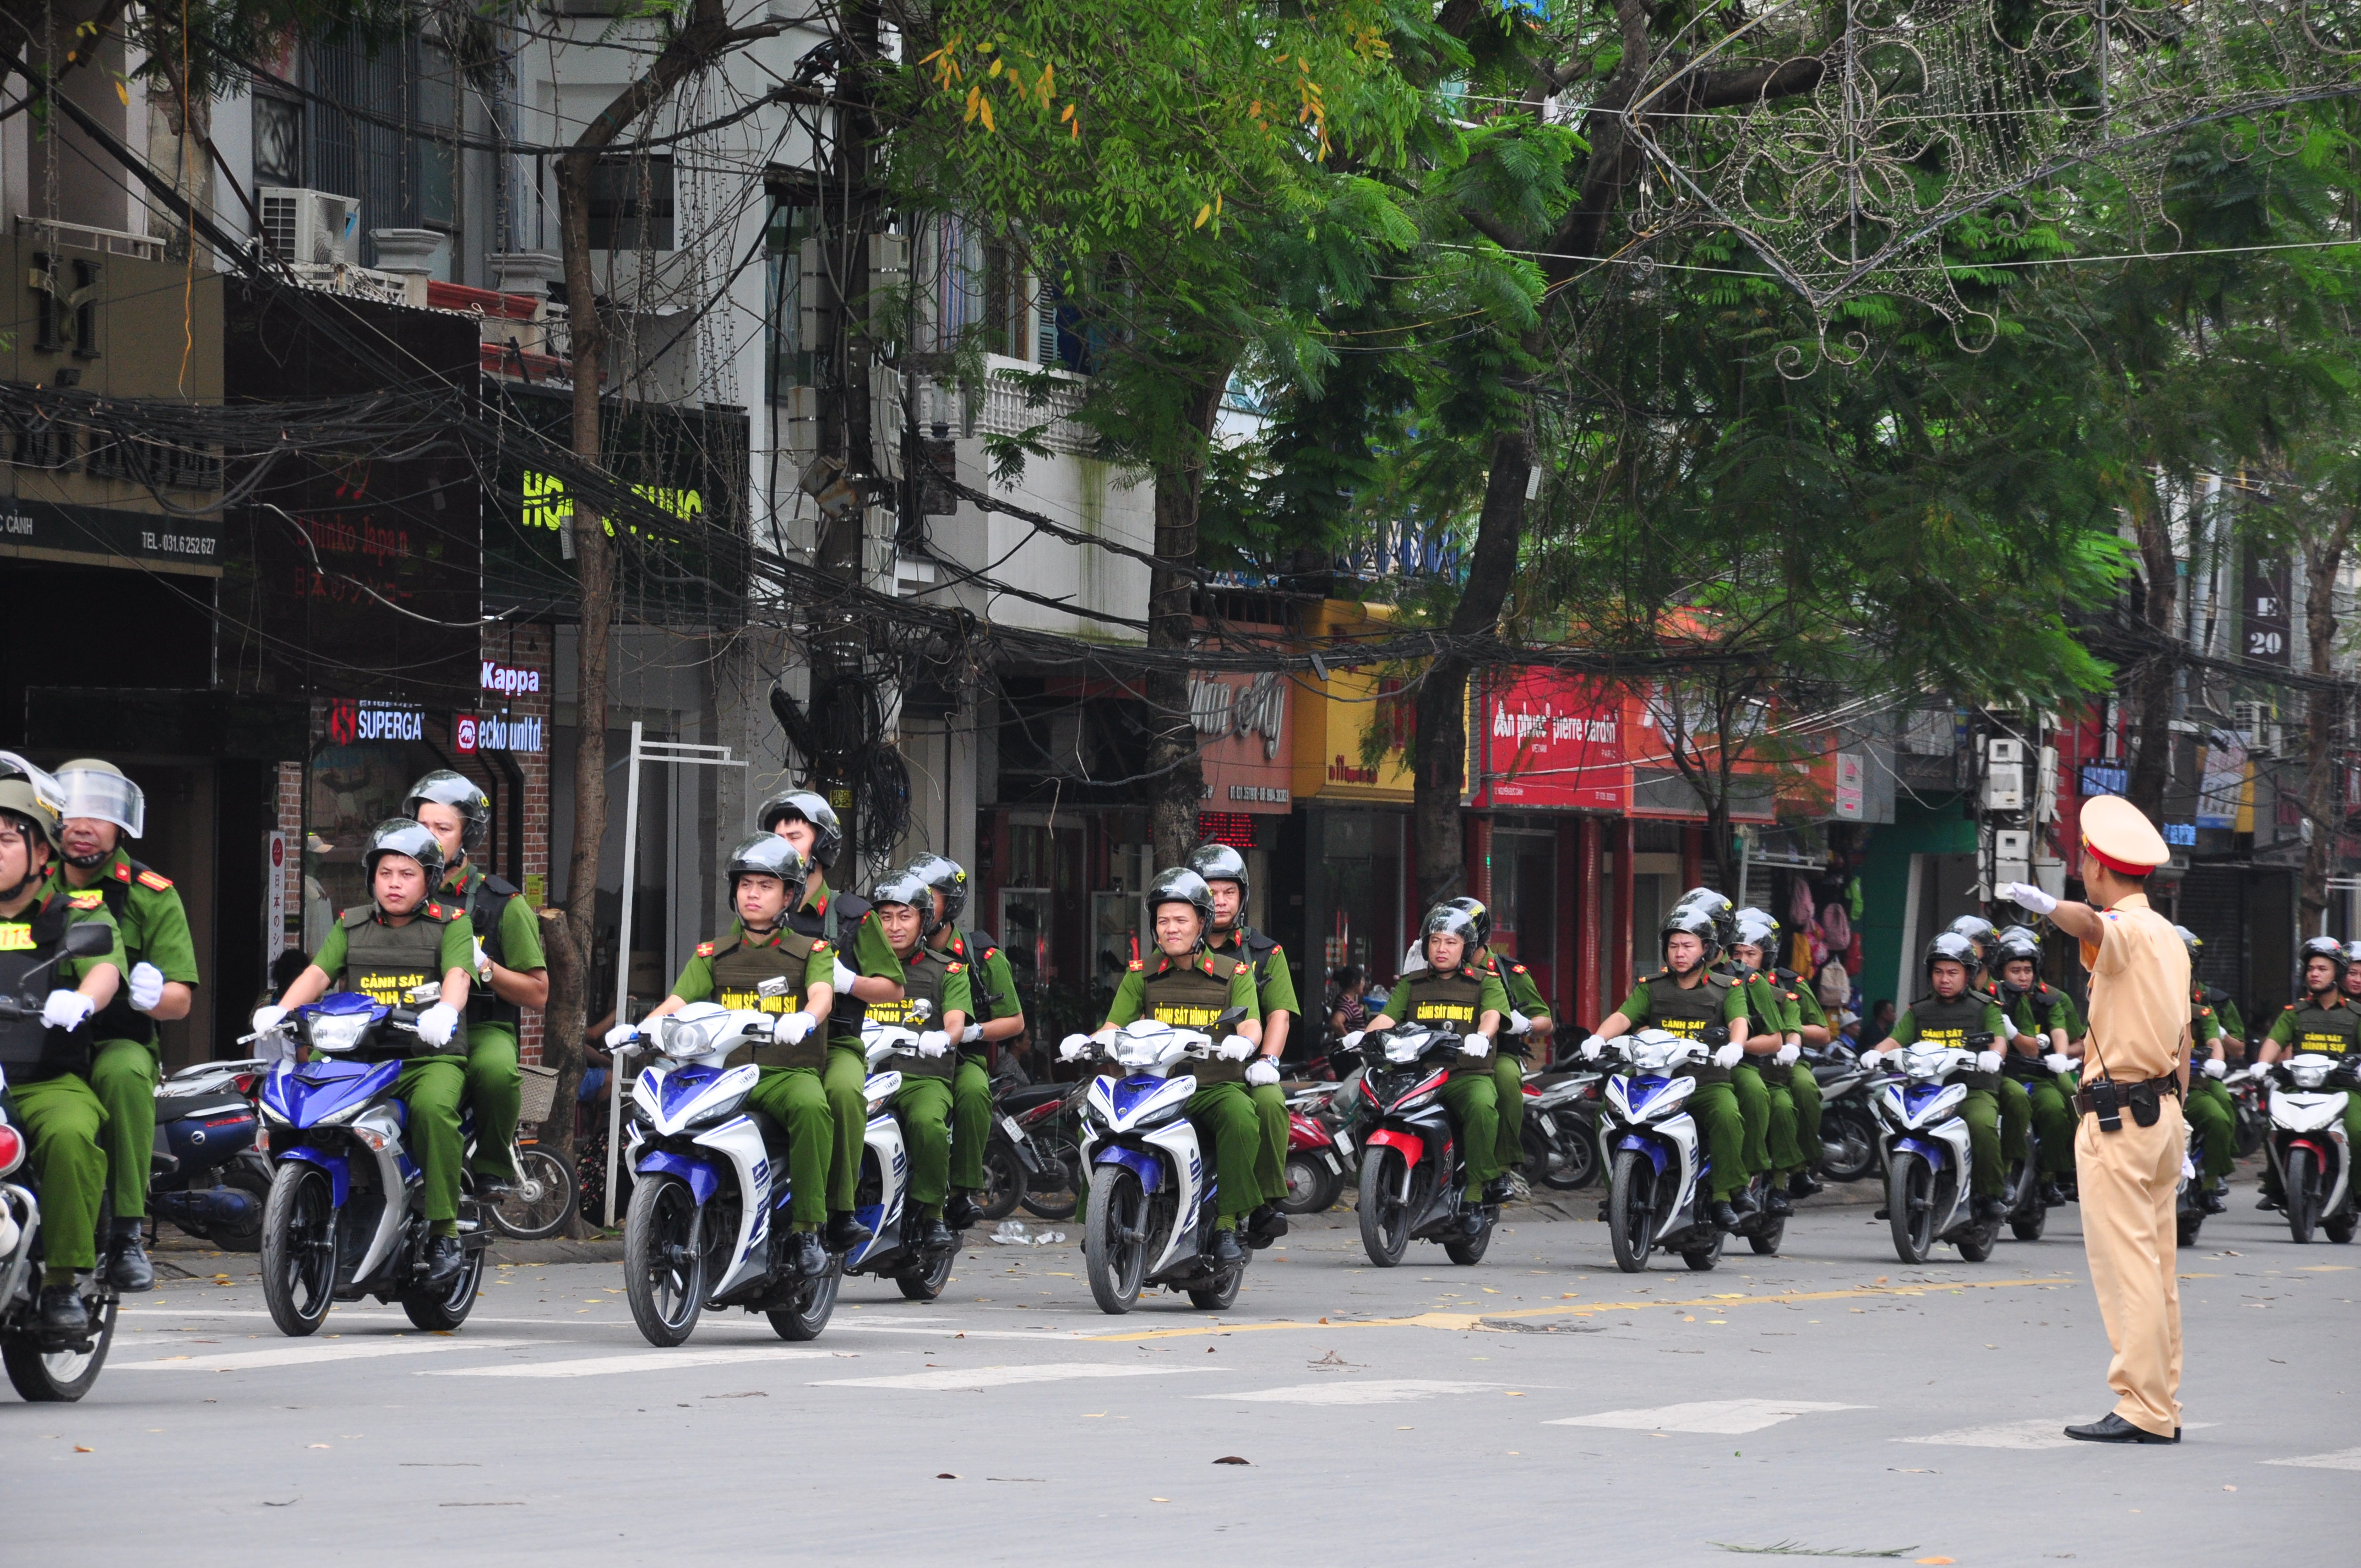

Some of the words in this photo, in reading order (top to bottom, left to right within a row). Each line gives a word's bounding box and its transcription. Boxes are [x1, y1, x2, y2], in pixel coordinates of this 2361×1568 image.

[7, 509, 33, 535] CẢNH
[362, 514, 409, 567] Japan
[2250, 632, 2282, 655] 20
[482, 662, 539, 696] Kappa
[358, 710, 422, 740] SUPERGA
[478, 715, 507, 750] ecko
[1553, 709, 1582, 745] pierre
[1585, 714, 1616, 744] cardin
[361, 973, 396, 988] CẢNH
[399, 973, 424, 987] SÁT
[722, 987, 742, 1010] CẢNH
[1155, 1001, 1173, 1024] CẢNH
[1174, 1005, 1189, 1025] SÁT
[1189, 1006, 1209, 1025] HÌNH
[1417, 1001, 1433, 1019] CẢNH
[1434, 1004, 1446, 1019] SÁT
[1447, 1004, 1463, 1020] HÌNH
[1464, 1006, 1475, 1023] SỰ
[1661, 1018, 1686, 1029] CẢNH
[1688, 1021, 1706, 1030] SÁT
[1921, 1028, 1945, 1038] CẢNH
[1945, 1028, 1963, 1038] SÁT
[2301, 1041, 2327, 1050] HÌNH
[2329, 1043, 2346, 1053] SỰ
[2304, 1032, 2326, 1041] CẢNH
[2326, 1034, 2343, 1042] SÁT
[739, 1070, 757, 1085] YAMAHA
[884, 1077, 899, 1090] YAMAHA
[174, 1087, 197, 1096] mode
